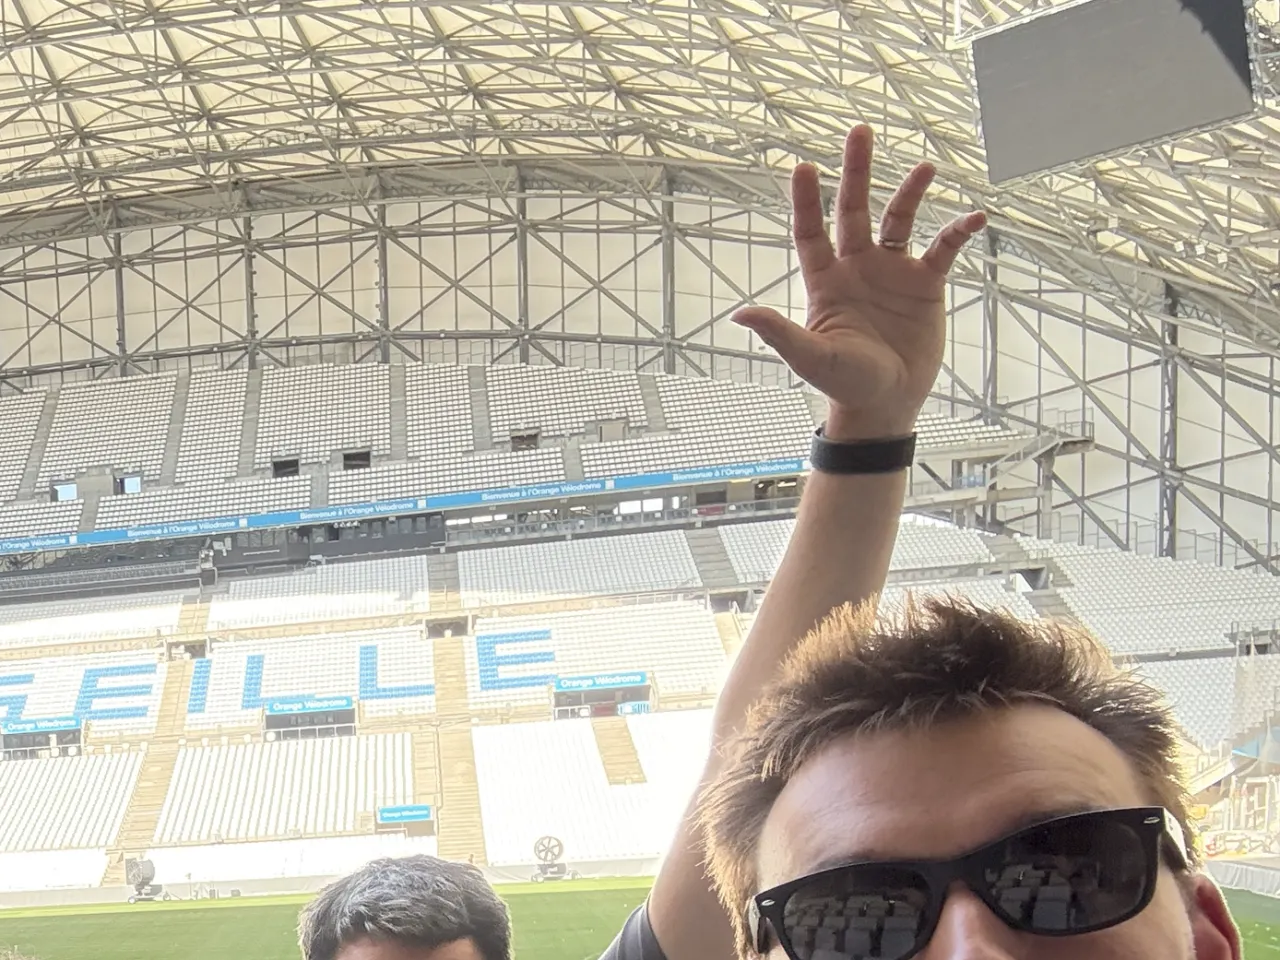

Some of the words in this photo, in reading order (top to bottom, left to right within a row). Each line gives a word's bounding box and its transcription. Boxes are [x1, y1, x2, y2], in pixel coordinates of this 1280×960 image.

[560, 679, 593, 688] Orange
[272, 702, 303, 711] Orange
[7, 723, 35, 731] Orange
